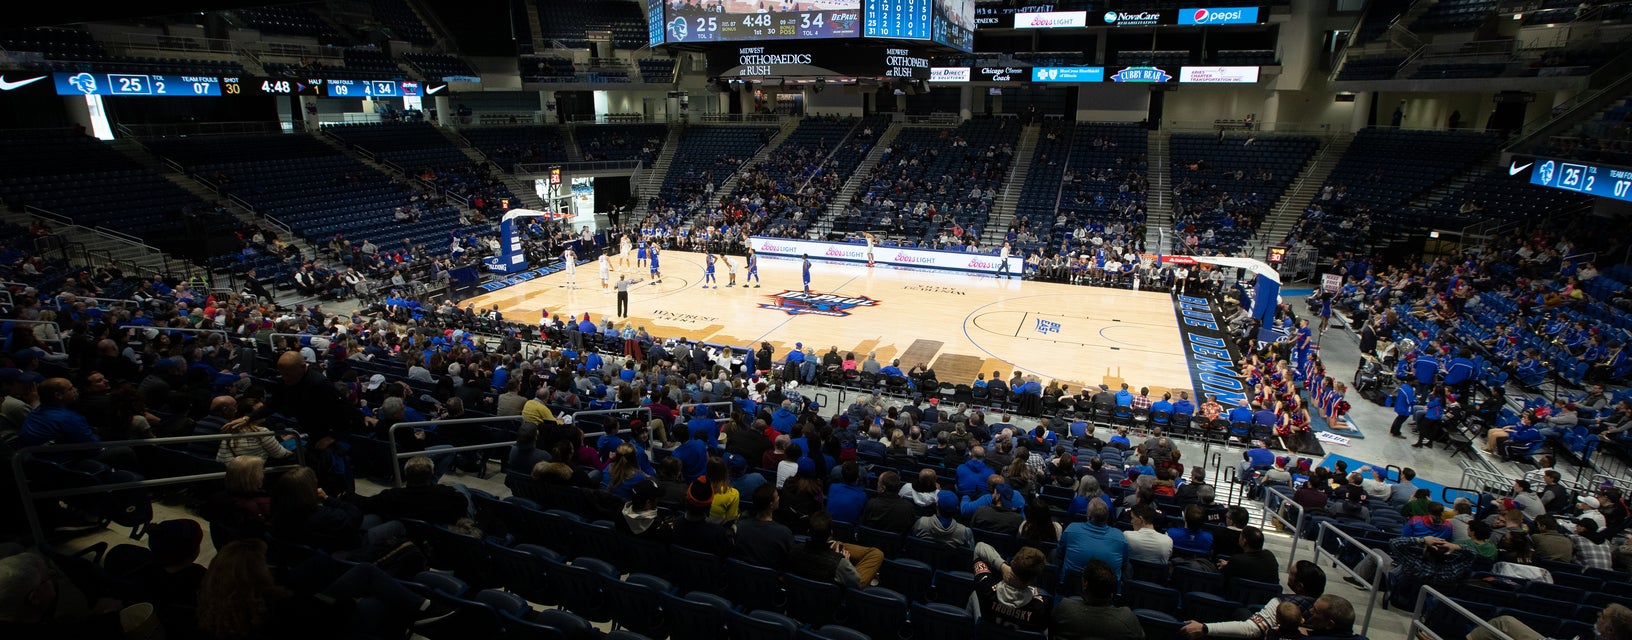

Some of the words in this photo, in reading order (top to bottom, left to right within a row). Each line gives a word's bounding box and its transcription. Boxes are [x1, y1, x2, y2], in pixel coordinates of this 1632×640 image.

[743, 14, 771, 27] 4:48
[800, 13, 824, 29] 34
[1117, 12, 1160, 20] NovaCare
[1210, 10, 1241, 22] pepsi
[696, 17, 717, 32] 25
[1031, 17, 1052, 26] Coors
[740, 54, 812, 65] ORTHOPAEDICS
[886, 56, 929, 68] ORTHOPAEDICS
[747, 66, 770, 75] RUSH
[893, 68, 912, 77] RUSH
[1121, 70, 1142, 79] CUBBY
[1144, 70, 1161, 80] BEAR
[119, 78, 142, 91] 25
[156, 82, 166, 93] 2
[194, 83, 209, 94] 07
[226, 84, 240, 94] 30
[262, 80, 290, 93] 4:48
[314, 85, 319, 94] 1
[378, 84, 391, 94] 34
[336, 86, 348, 95] 09
[364, 86, 370, 95] 4
[1563, 168, 1580, 186] 25
[1610, 170, 1624, 178] TEAM
[1585, 176, 1595, 191] 2
[1614, 180, 1631, 197] 07
[761, 243, 779, 252] Coors
[826, 248, 845, 256] Coors
[895, 253, 915, 263] Coors
[968, 259, 990, 269] Coors
[1178, 294, 1219, 330] BLUE
[1322, 433, 1347, 442] BLUE
